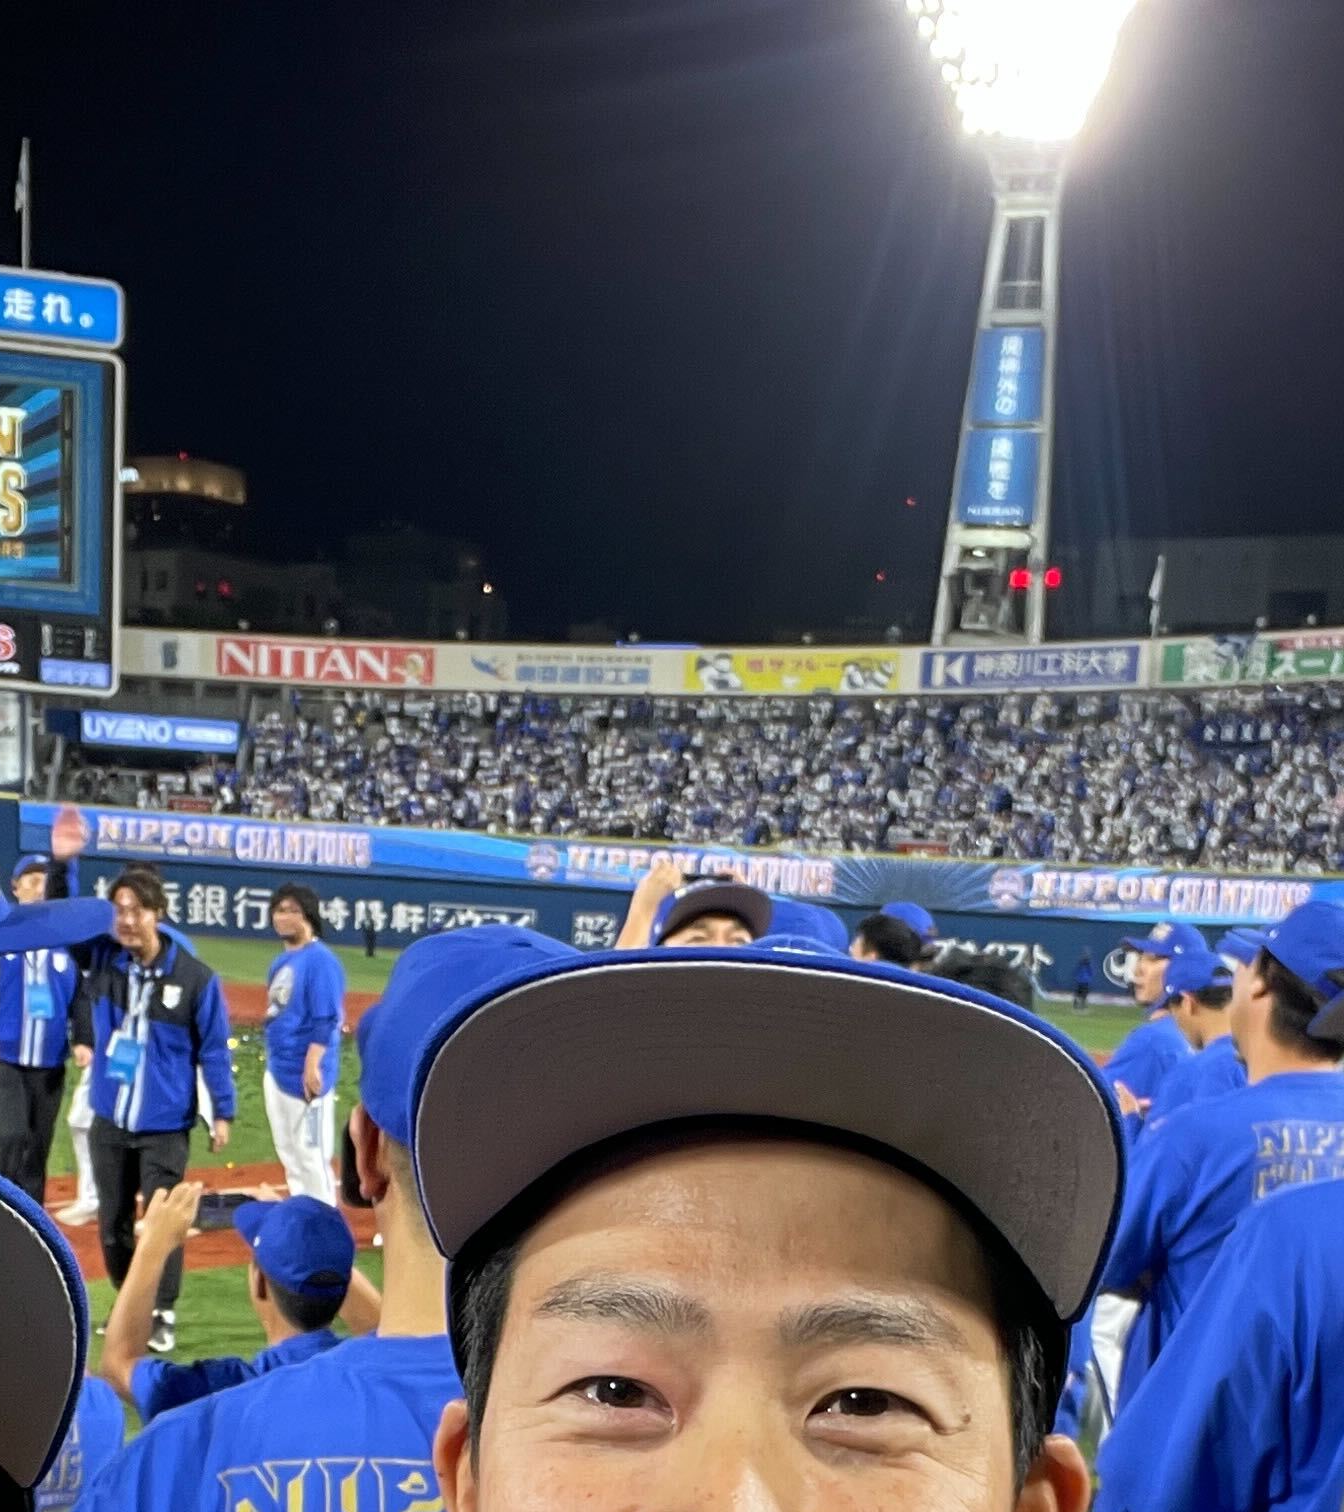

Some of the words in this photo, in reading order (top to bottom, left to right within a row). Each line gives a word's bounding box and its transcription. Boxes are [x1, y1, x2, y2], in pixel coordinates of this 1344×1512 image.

[222, 638, 395, 684] NITTAN
[83, 714, 172, 744] UYENO
[96, 815, 235, 848] NIPPON
[235, 824, 372, 869] CHAMPIONS
[1031, 871, 1170, 903] NIPPON
